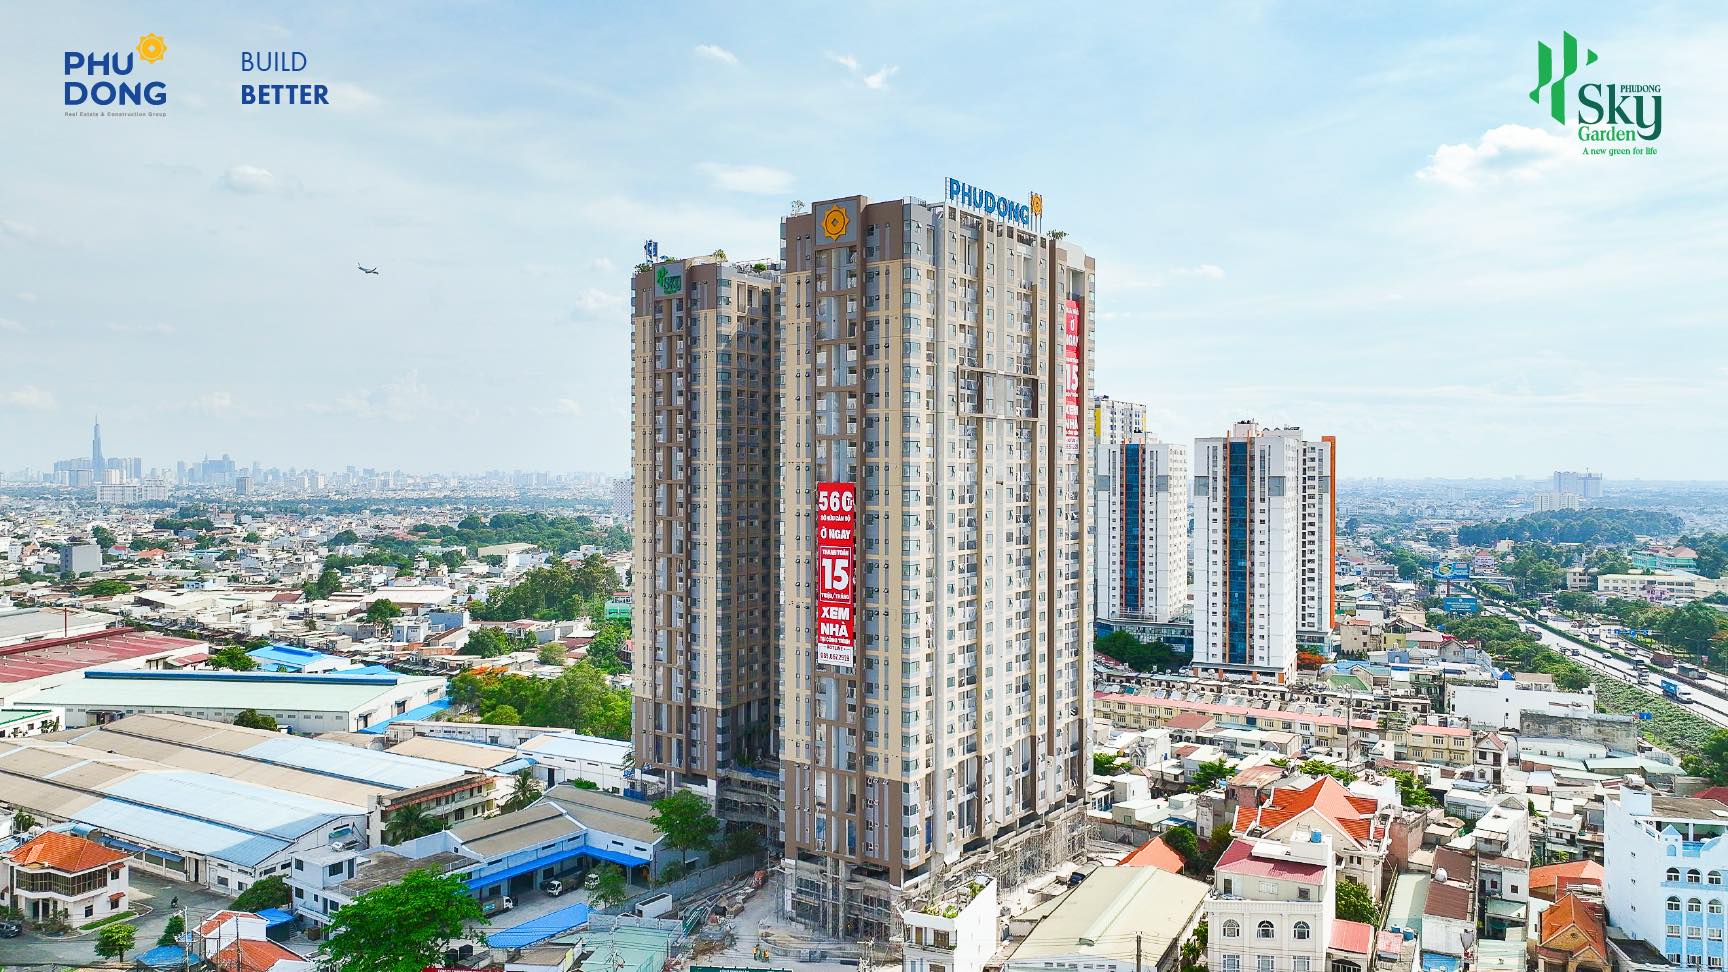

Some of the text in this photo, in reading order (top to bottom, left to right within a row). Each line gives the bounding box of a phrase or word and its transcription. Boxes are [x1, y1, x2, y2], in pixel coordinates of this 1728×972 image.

[949, 177, 1030, 226] PHUDONG
[1064, 363, 1079, 391] 15
[829, 529, 851, 540] NGAY
[821, 558, 849, 591] 15
[820, 606, 850, 621] XEM
[820, 621, 849, 637] NHÀ
